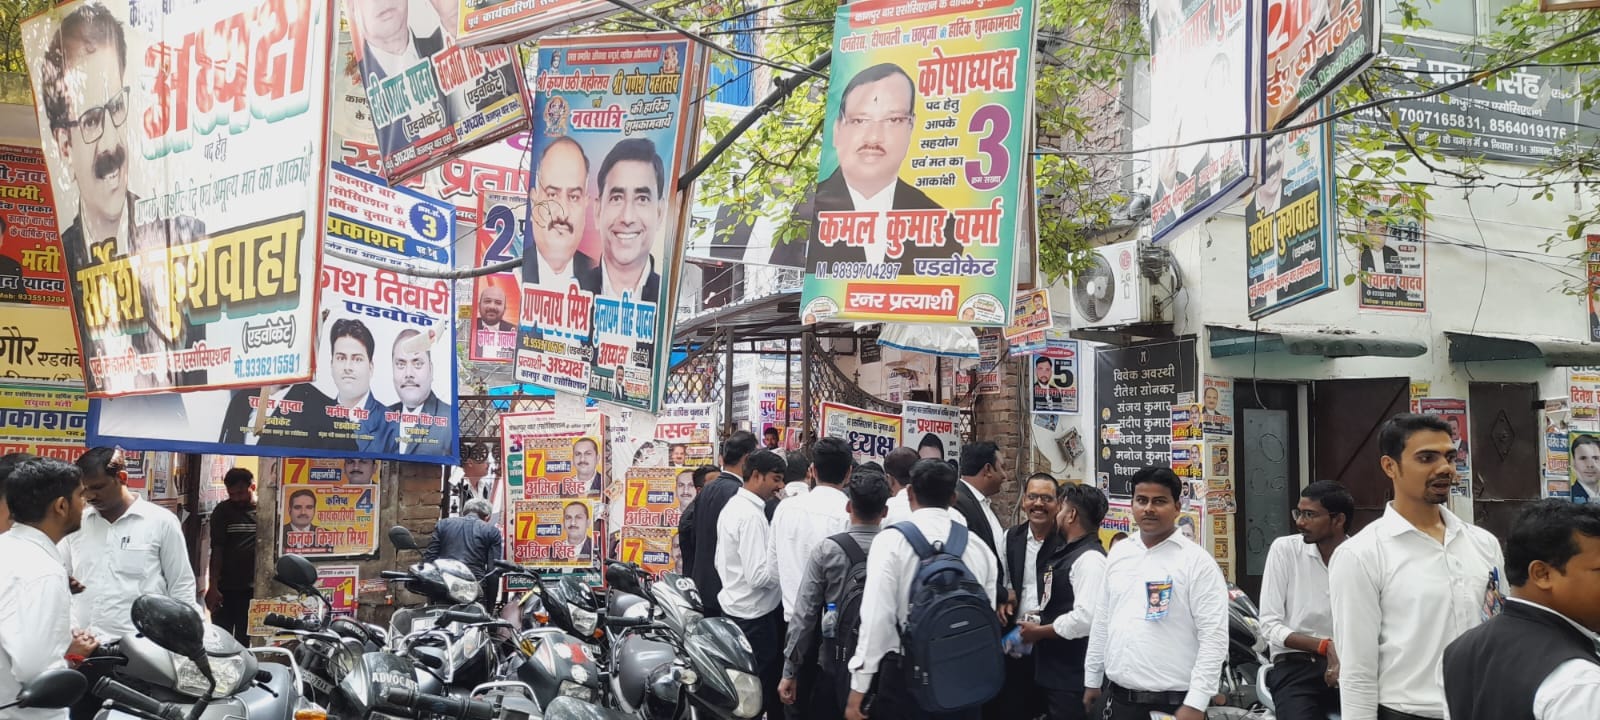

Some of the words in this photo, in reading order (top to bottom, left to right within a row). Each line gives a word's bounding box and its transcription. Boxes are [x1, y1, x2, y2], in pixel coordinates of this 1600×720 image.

[871, 28, 900, 47] दीपावली
[948, 18, 972, 38] हार्दिक
[648, 67, 681, 95] महोत्सव
[918, 47, 1018, 97] कोषाध्यक्ष
[464, 70, 507, 110] (एडवोकेट)
[571, 104, 626, 129] नवरात्रि
[643, 97, 669, 113] हार्दिक
[926, 101, 940, 110] पद
[943, 98, 960, 113] हेतु
[402, 104, 447, 142] (एडवोकेट)
[463, 112, 485, 134] अध्यक्ष
[925, 116, 957, 130] आपके
[1399, 107, 1486, 133] 7007165831,
[1489, 118, 1567, 140] 8564019176
[920, 135, 958, 149] सहयोग
[964, 104, 1011, 190] 3
[911, 155, 928, 168] एवं
[929, 157, 946, 167] मत
[949, 157, 964, 166] का
[335, 172, 374, 193] कानपुर
[378, 187, 396, 200] बार
[916, 173, 956, 187] आकांक्षी
[364, 207, 392, 224] चुनाव
[422, 216, 437, 238] 3
[818, 211, 879, 245] कमल
[886, 210, 949, 256] कुमार
[953, 198, 1002, 245] वर्मा
[1275, 191, 1319, 256] कुशवाहा
[327, 216, 405, 253] प्रकाशन
[816, 262, 828, 278] M.
[832, 262, 902, 280] 9839704297
[914, 253, 996, 276] एडवोकेट
[22, 277, 65, 292] यादव
[153, 216, 304, 341] कुशवाहा
[375, 268, 450, 315] तिवारी
[849, 291, 886, 309] रनर
[887, 287, 955, 312] प्रत्याशी
[521, 288, 564, 326] प्राणनाथ
[567, 284, 591, 331] मिश्र
[636, 303, 657, 341] यादव
[242, 317, 296, 353] (एडवोकेट)
[599, 343, 630, 366] अध्यक्ष
[521, 370, 540, 383] कानपुर
[1054, 359, 1074, 388] 5
[1114, 368, 1139, 382] विवेक
[1141, 363, 1175, 379] अवस्थी
[1113, 382, 1138, 397] रीतेश
[1140, 382, 1175, 396] सोनकर
[1570, 385, 1593, 403] दिनेश
[279, 398, 304, 414] गुप्ता
[1117, 401, 1141, 413] संजय
[1143, 401, 1171, 415] कुमार
[917, 417, 953, 434] प्रशासन
[1118, 415, 1141, 429] संदीप
[1144, 416, 1171, 431] कुमार
[846, 430, 895, 458] ध्यक्ष
[1118, 431, 1142, 445] विनोद
[1144, 433, 1171, 449] कुमार
[528, 453, 543, 477] 7
[1116, 448, 1143, 461] मनोज
[1145, 450, 1172, 465] कुमार
[288, 458, 307, 484] 7
[526, 479, 560, 495] अमित
[562, 478, 585, 495] सिंह
[630, 482, 644, 506] 7
[355, 488, 373, 514] 4
[519, 515, 533, 539] 7
[626, 508, 661, 526] अमित
[664, 508, 681, 526] सिं
[287, 531, 315, 547] कनक
[315, 527, 345, 547] किशोर
[346, 526, 369, 546] मिश्रा
[515, 541, 550, 559] अमित
[552, 540, 575, 559] सिंह
[625, 541, 640, 564] 7
